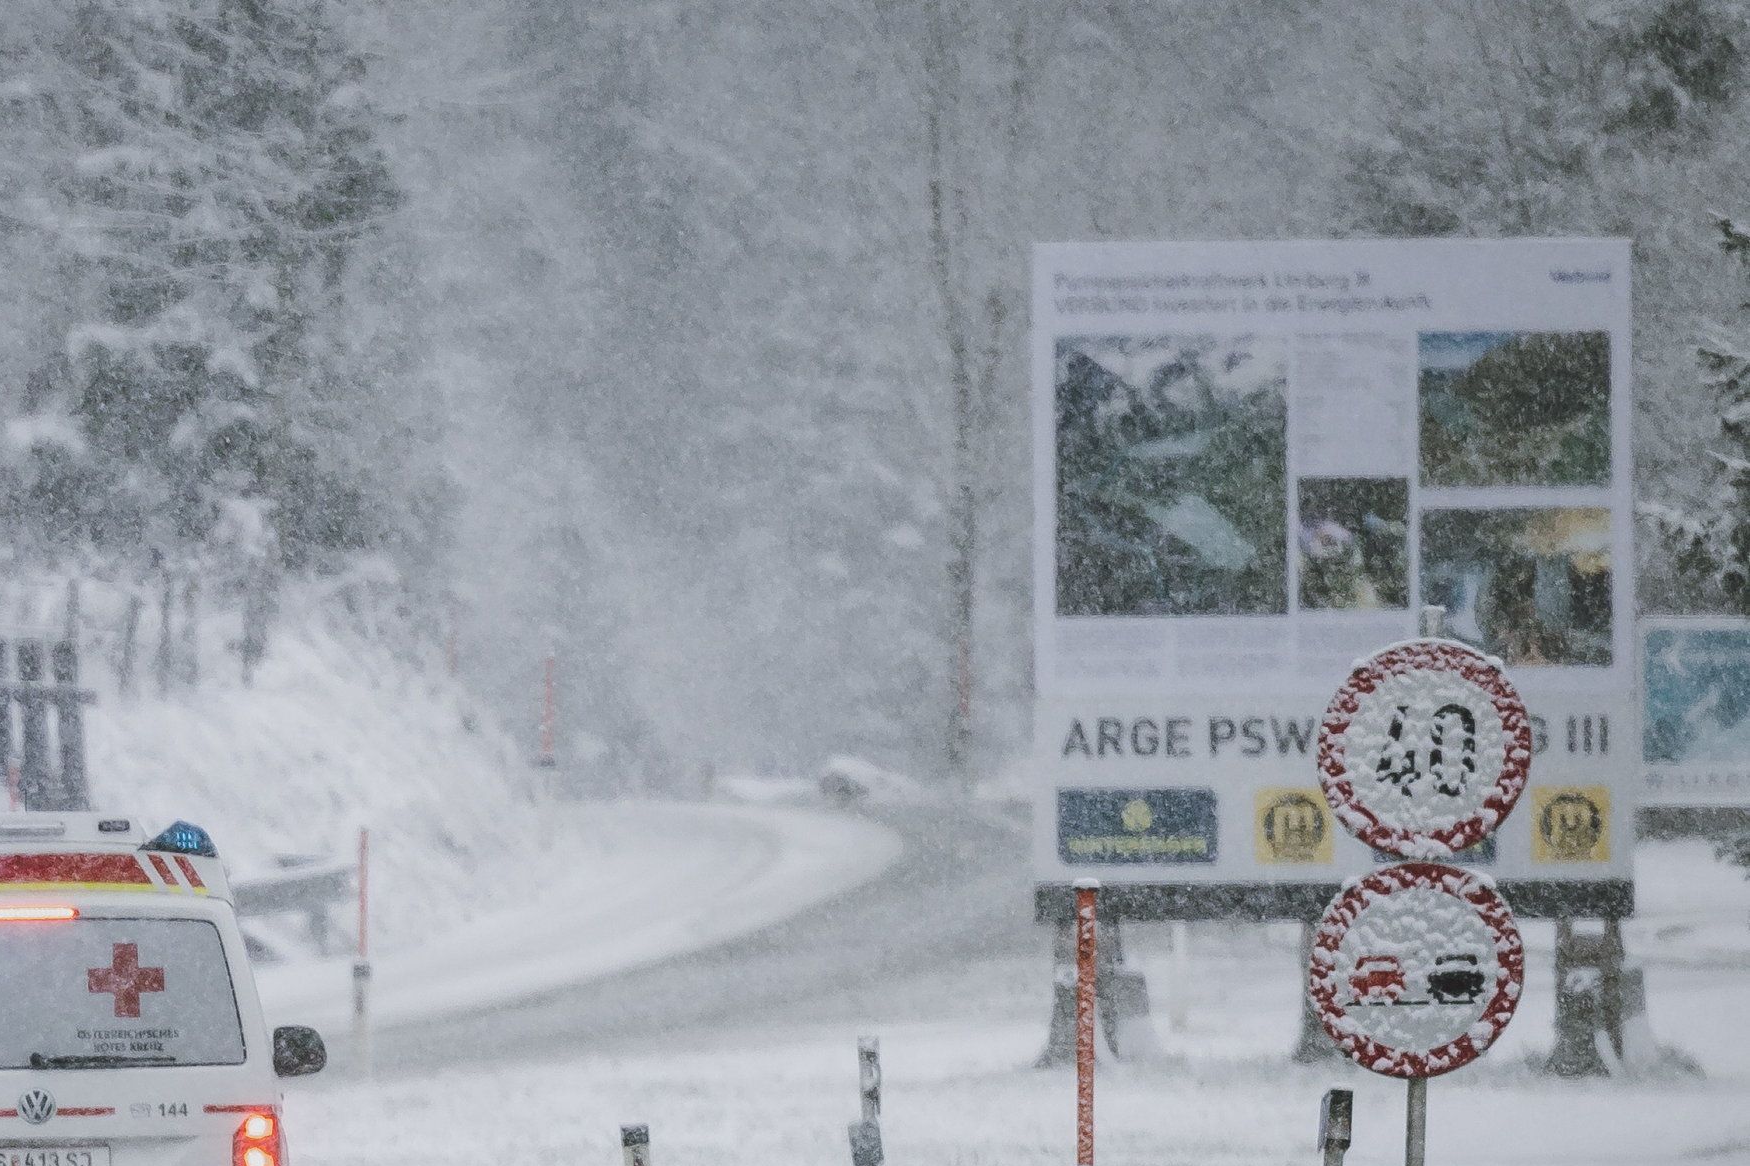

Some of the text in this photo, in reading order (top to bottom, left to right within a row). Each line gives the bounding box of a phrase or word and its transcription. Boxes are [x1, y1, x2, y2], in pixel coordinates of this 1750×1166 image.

[1061, 716, 1194, 759] ARGE
[1208, 715, 1317, 758] PSW
[1567, 713, 1609, 755] III
[1375, 703, 1476, 798] 40
[157, 1102, 189, 1118] 144
